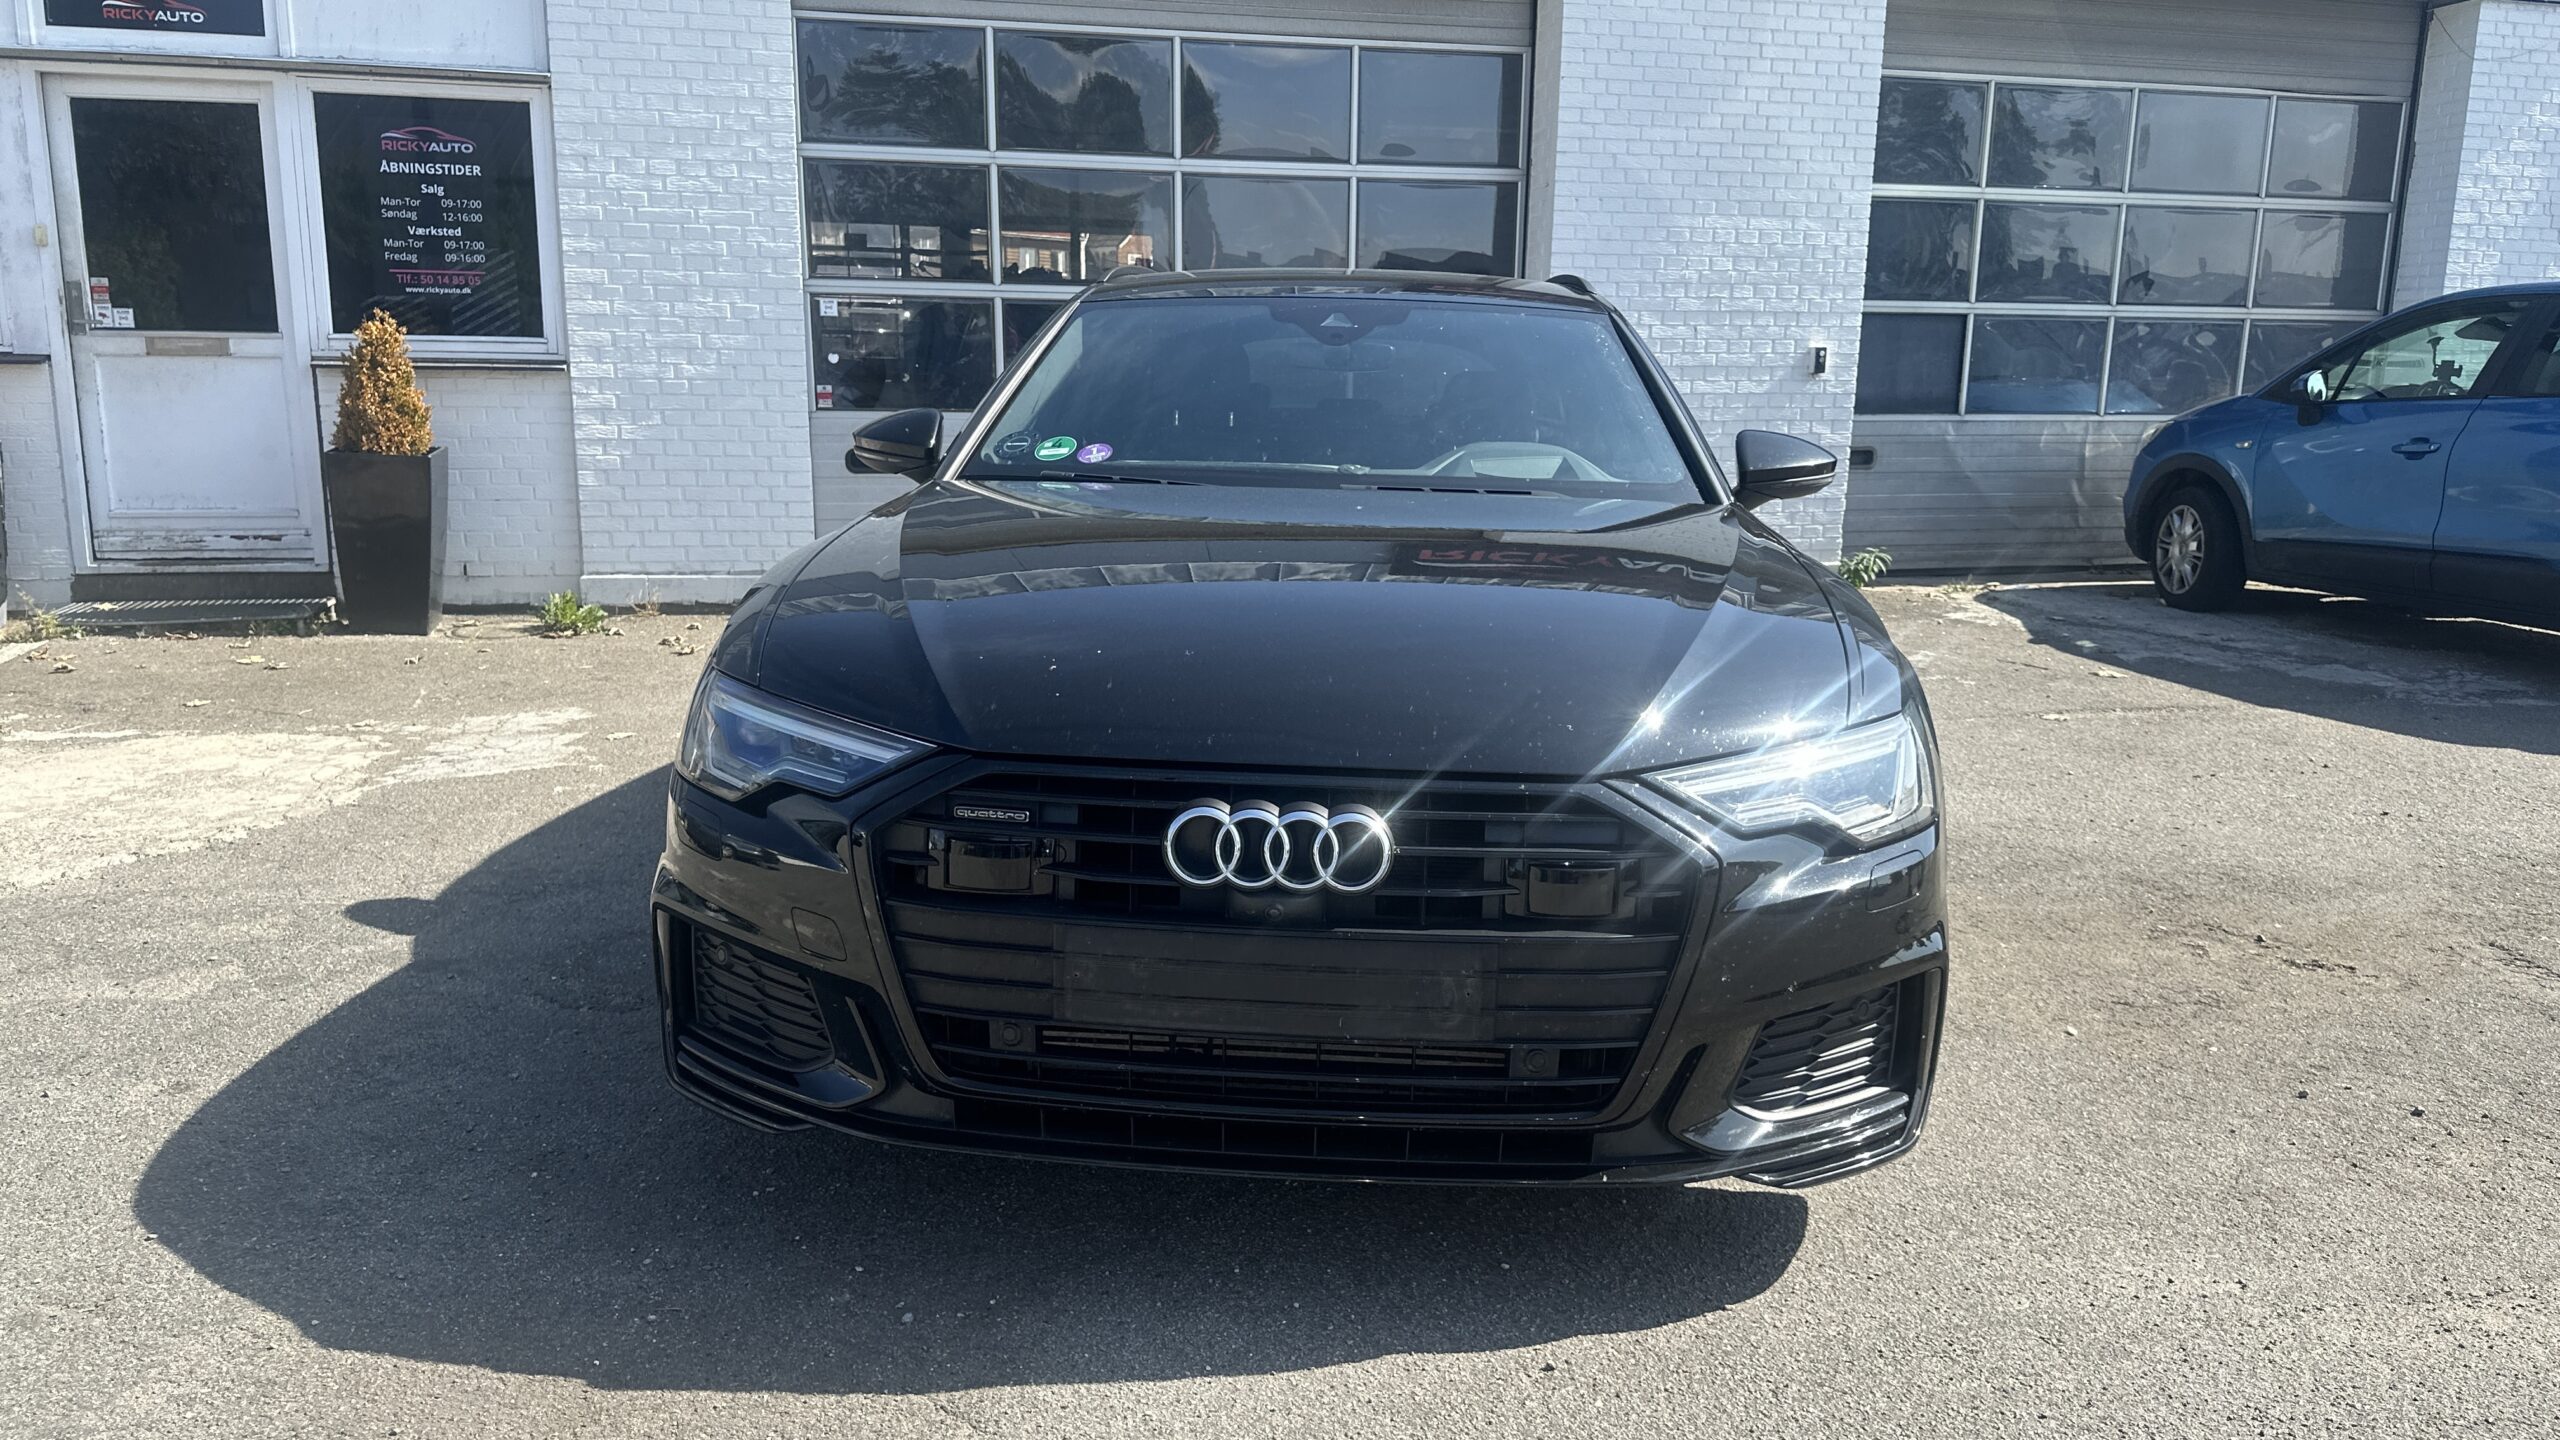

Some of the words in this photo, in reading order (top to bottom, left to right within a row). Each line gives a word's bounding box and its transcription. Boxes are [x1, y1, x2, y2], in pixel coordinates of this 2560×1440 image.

[102, 7, 205, 24] RICKYAUTO
[381, 140, 475, 154] RICKYAUTO
[380, 159, 482, 177] ÅBNINGSTIDER
[420, 183, 445, 197] Salg
[380, 196, 422, 207] Man-Tor
[440, 199, 483, 209] 09-17:00
[381, 208, 418, 221] Søndag
[442, 212, 484, 223] 12-16:00
[407, 225, 462, 237] Værksted
[383, 238, 425, 248] Man-Tor
[443, 240, 485, 250] 09-17:00
[384, 251, 419, 264] Fredag
[444, 253, 486, 263] 09-16:00
[420, 275, 434, 284] 50
[436, 275, 449, 285] 14
[468, 276, 481, 286] 05
[405, 286, 472, 295] www.rickyauto.dk
[956, 808, 1026, 821] quattro
